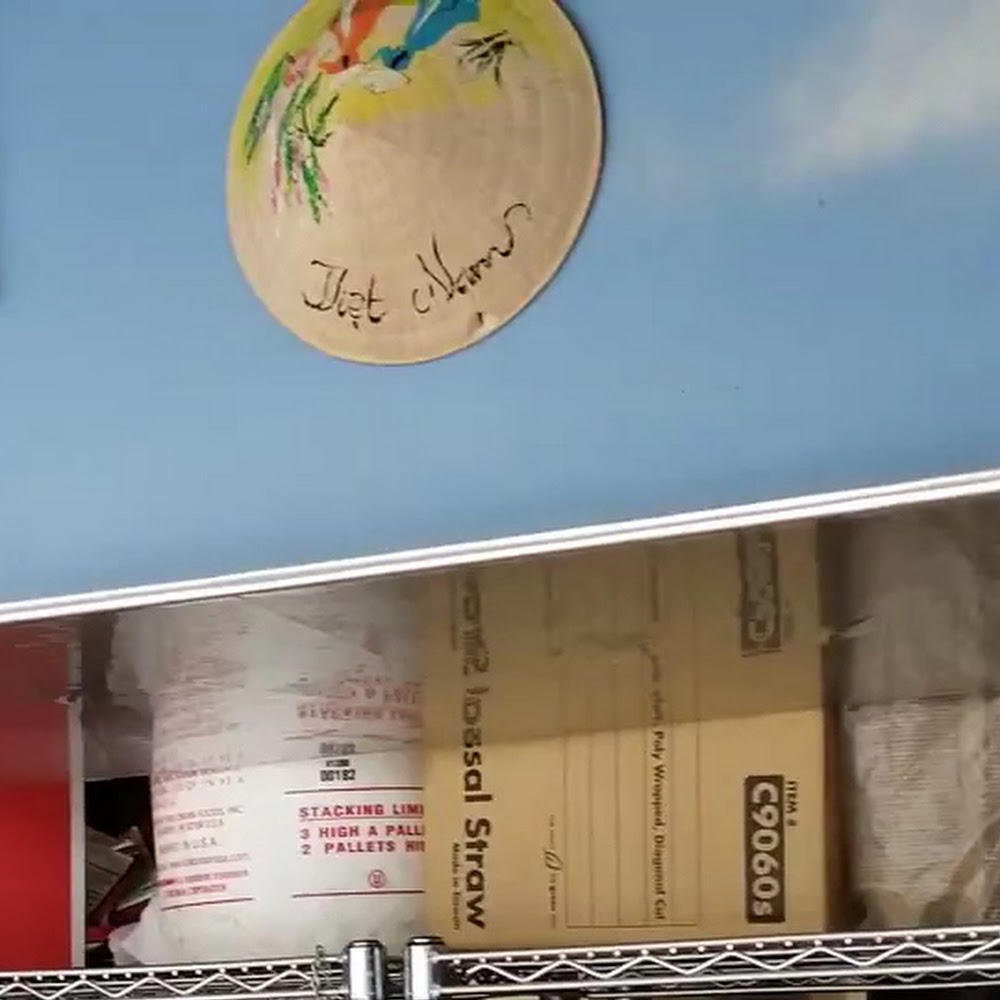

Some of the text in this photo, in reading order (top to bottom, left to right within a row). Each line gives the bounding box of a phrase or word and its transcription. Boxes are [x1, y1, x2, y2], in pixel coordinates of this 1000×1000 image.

[299, 803, 424, 818] STACKING LIMI
[300, 823, 424, 839] 3 HIGH A PALL
[301, 845, 311, 854] 2
[325, 841, 396, 853] PALLETS
[752, 782, 780, 917] C9060s
[464, 817, 491, 930] Straw
